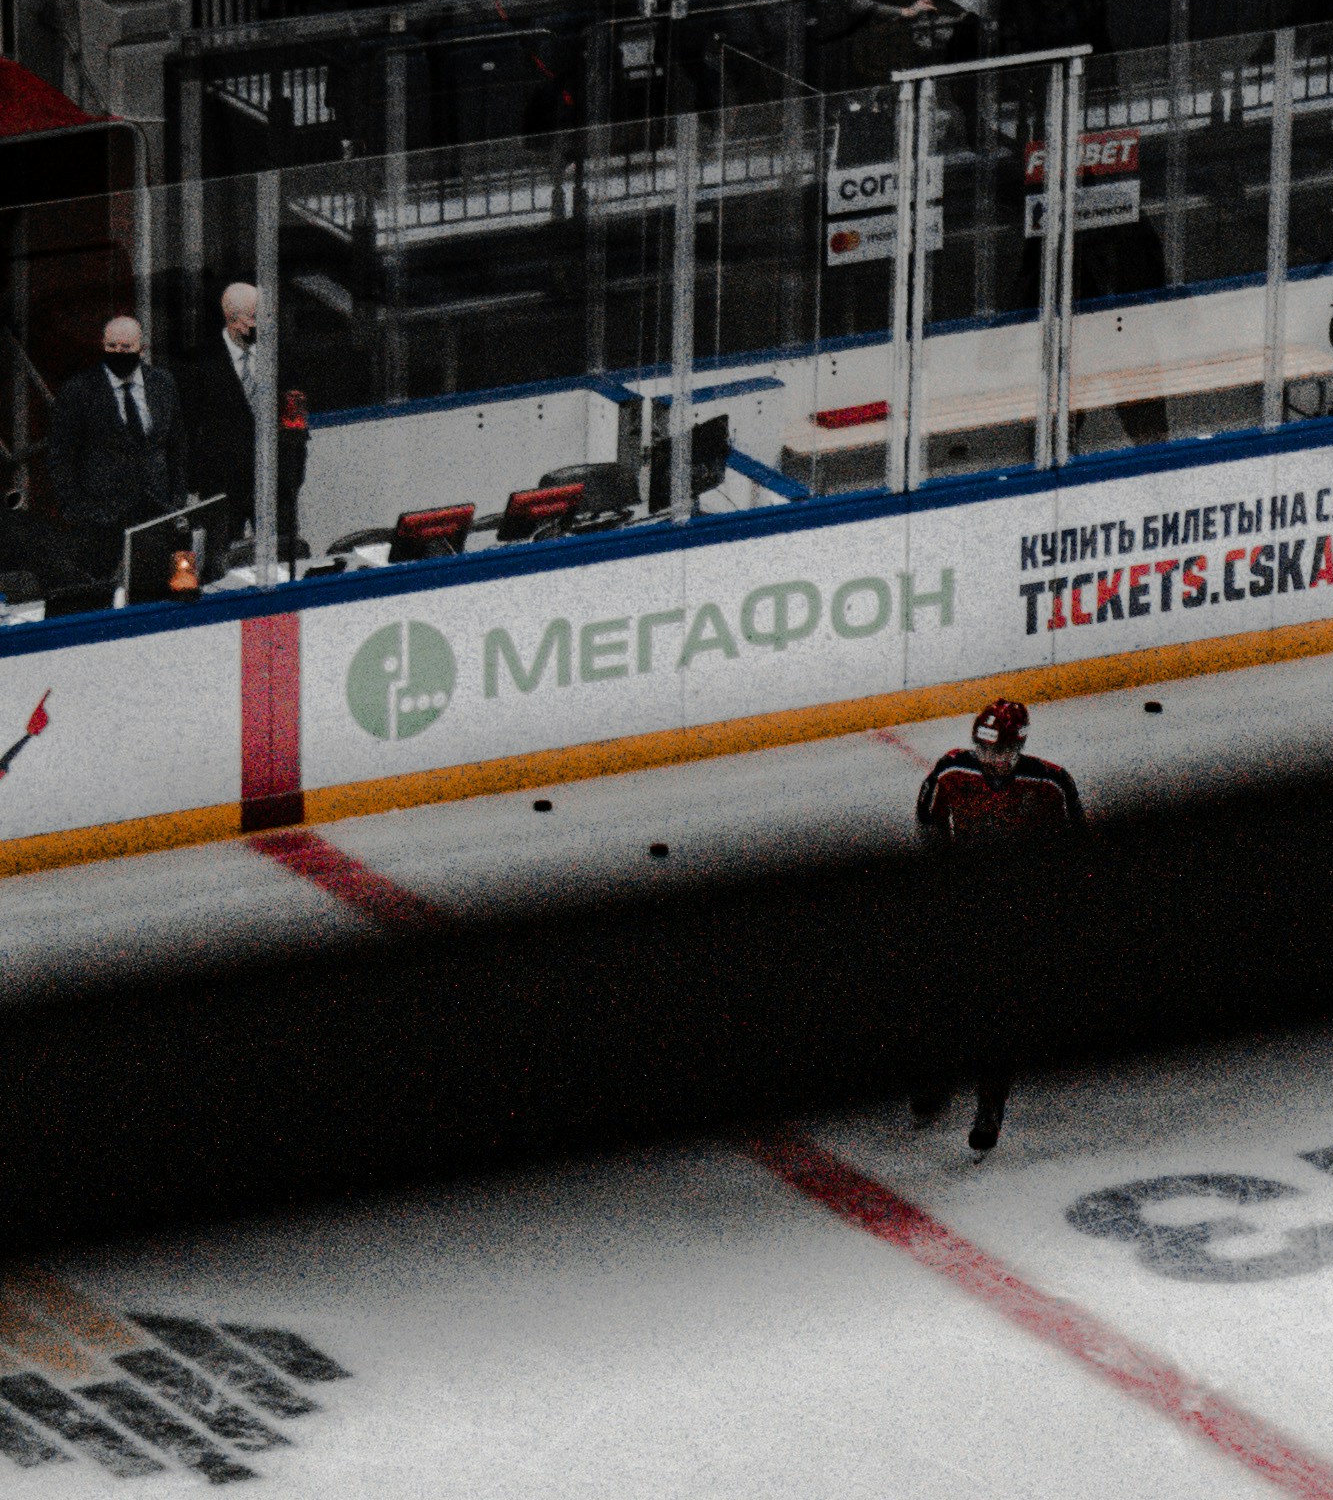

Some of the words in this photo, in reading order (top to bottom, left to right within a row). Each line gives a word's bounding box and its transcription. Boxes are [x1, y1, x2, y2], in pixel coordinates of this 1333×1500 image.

[1027, 138, 1138, 176] FBET
[1021, 520, 1136, 570] КУПИТЬ
[1142, 498, 1264, 551] БИЛЕТЫ
[1270, 490, 1307, 530] НА
[483, 567, 955, 699] МЕГАФОН
